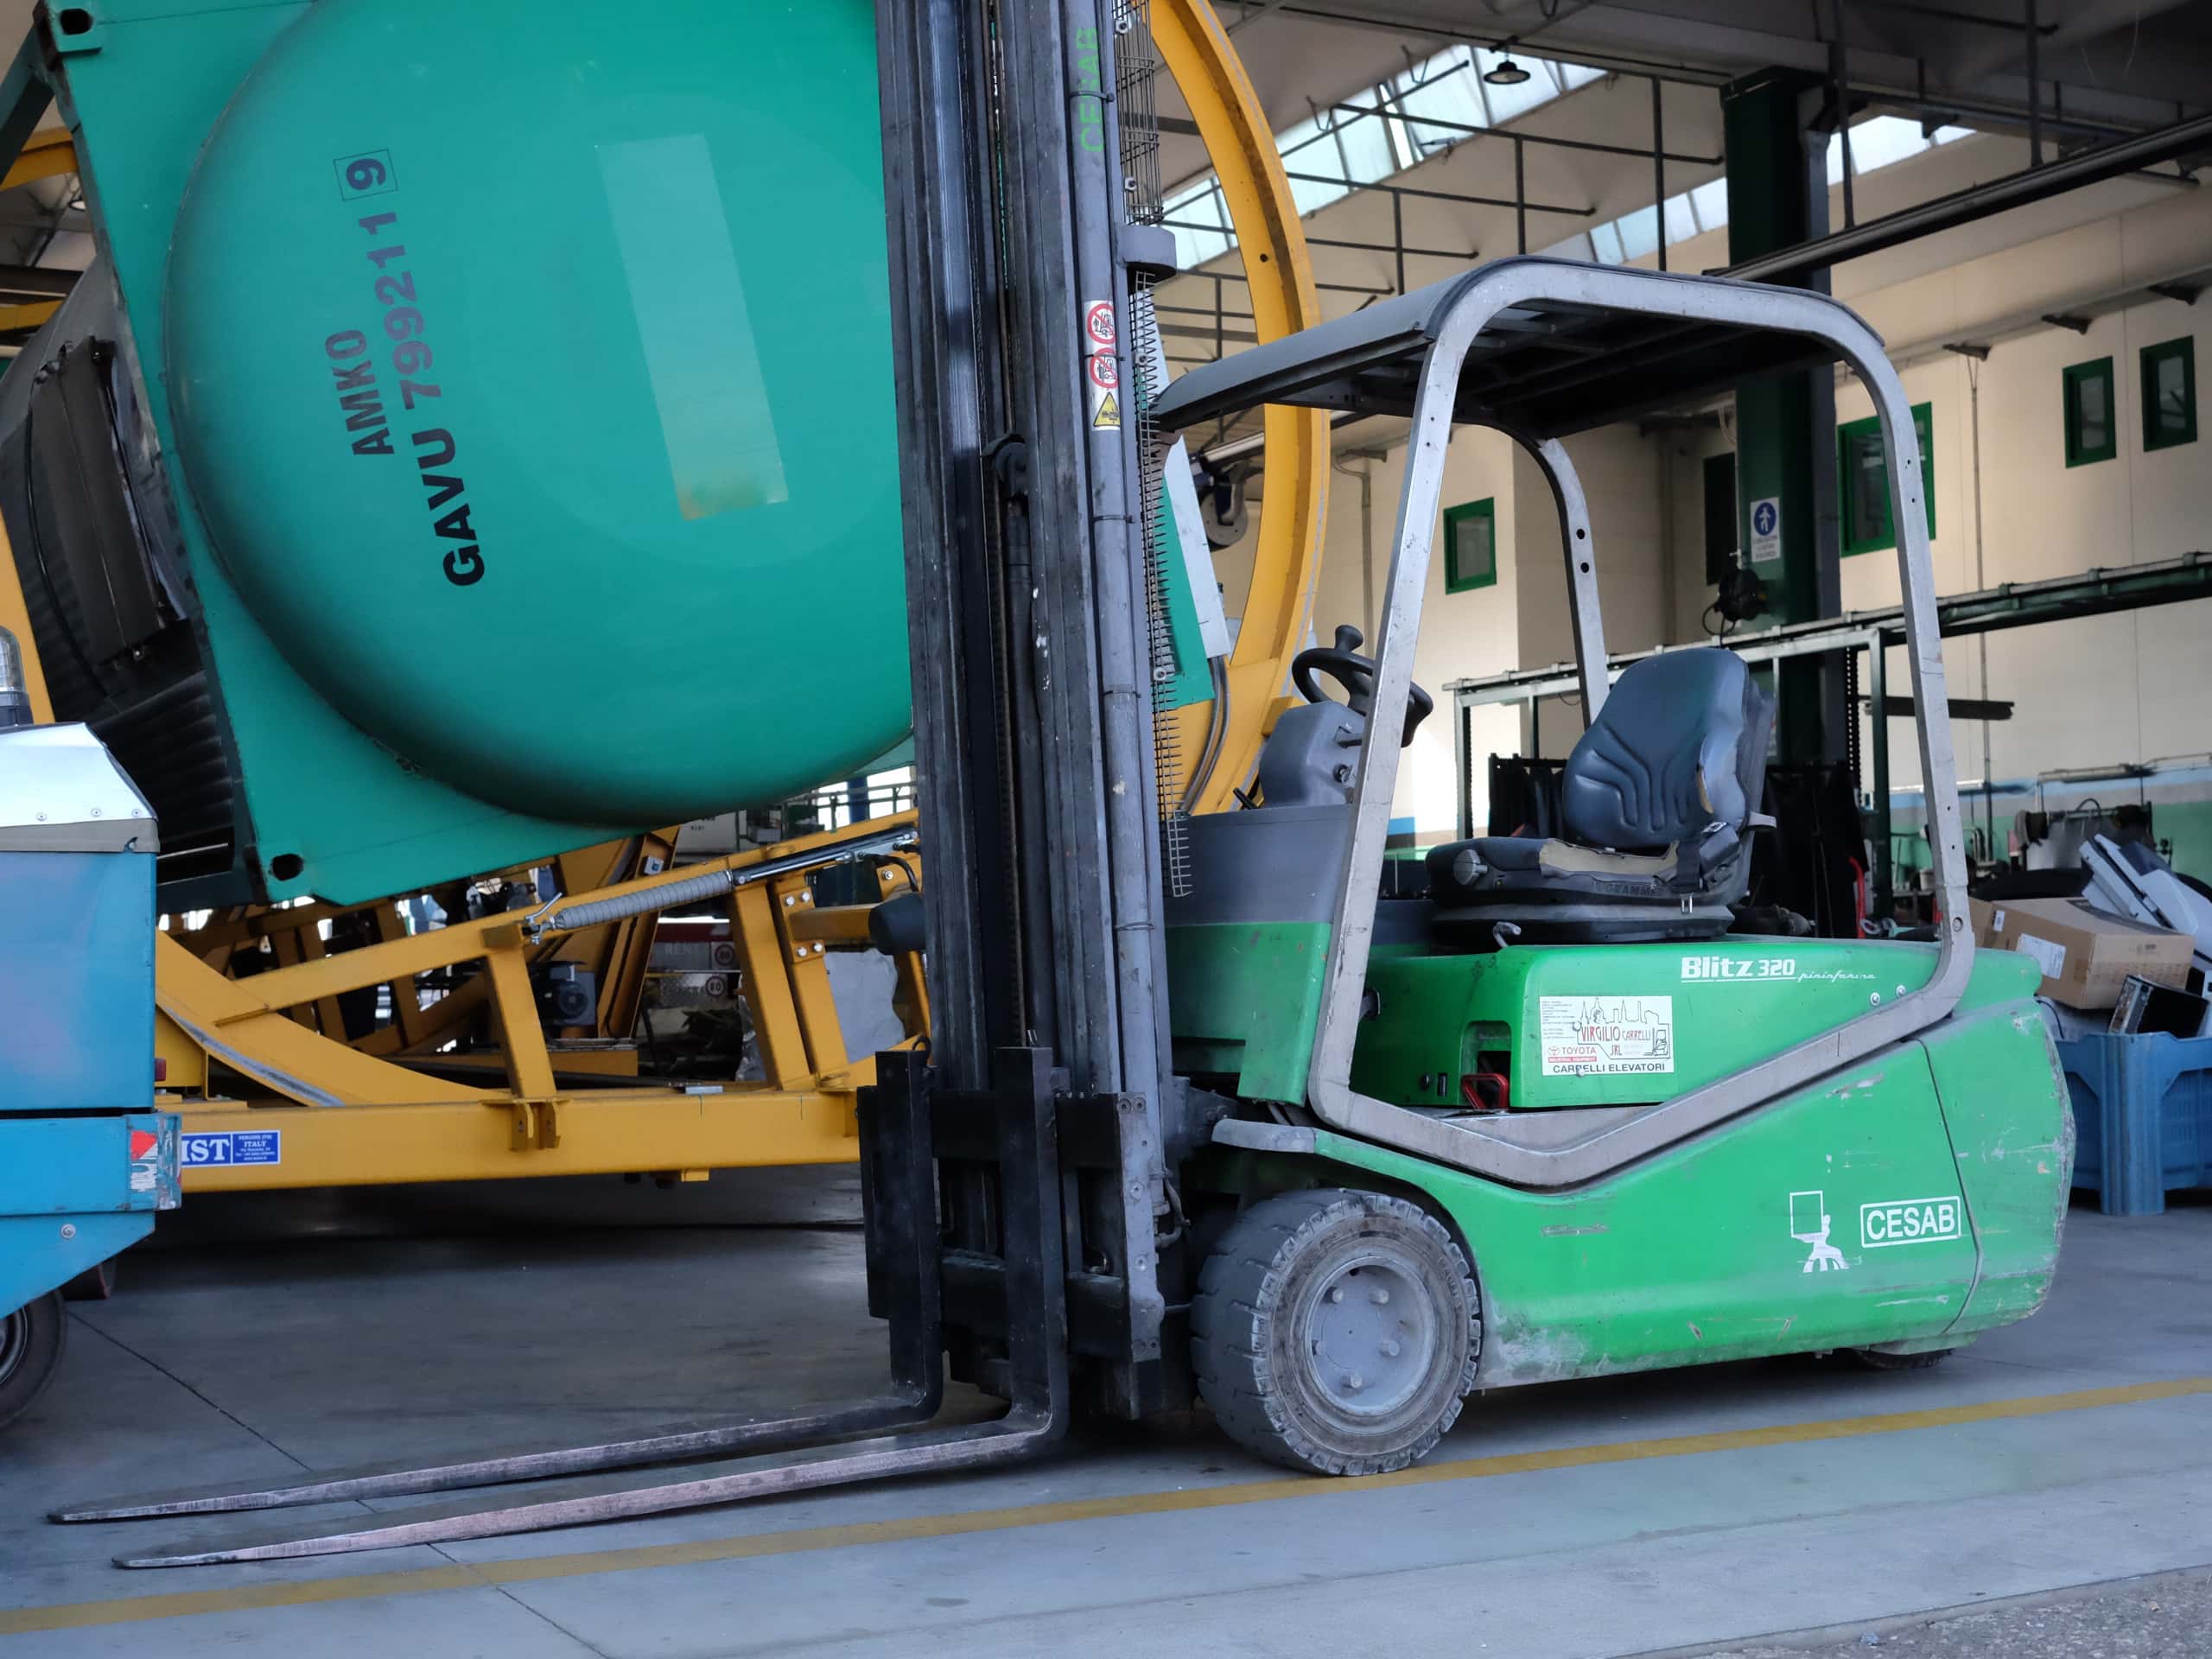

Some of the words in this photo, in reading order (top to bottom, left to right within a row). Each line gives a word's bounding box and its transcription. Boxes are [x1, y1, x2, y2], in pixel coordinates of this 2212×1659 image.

[346, 158, 387, 190] 9
[358, 211, 442, 410] 799211
[324, 328, 395, 457] AMKO
[411, 428, 486, 588] GAVU
[1681, 956, 1753, 979] Blitz
[1758, 958, 1796, 976] 320
[1581, 1026, 1621, 1042] VIRGILIO
[1622, 1029, 1651, 1041] CARRELLI
[1560, 1046, 1597, 1055] TOYOTA
[1610, 1044, 1623, 1056] SRL
[1608, 1063, 1665, 1072] ELEVATORI
[1866, 1205, 1955, 1240] CESAB
